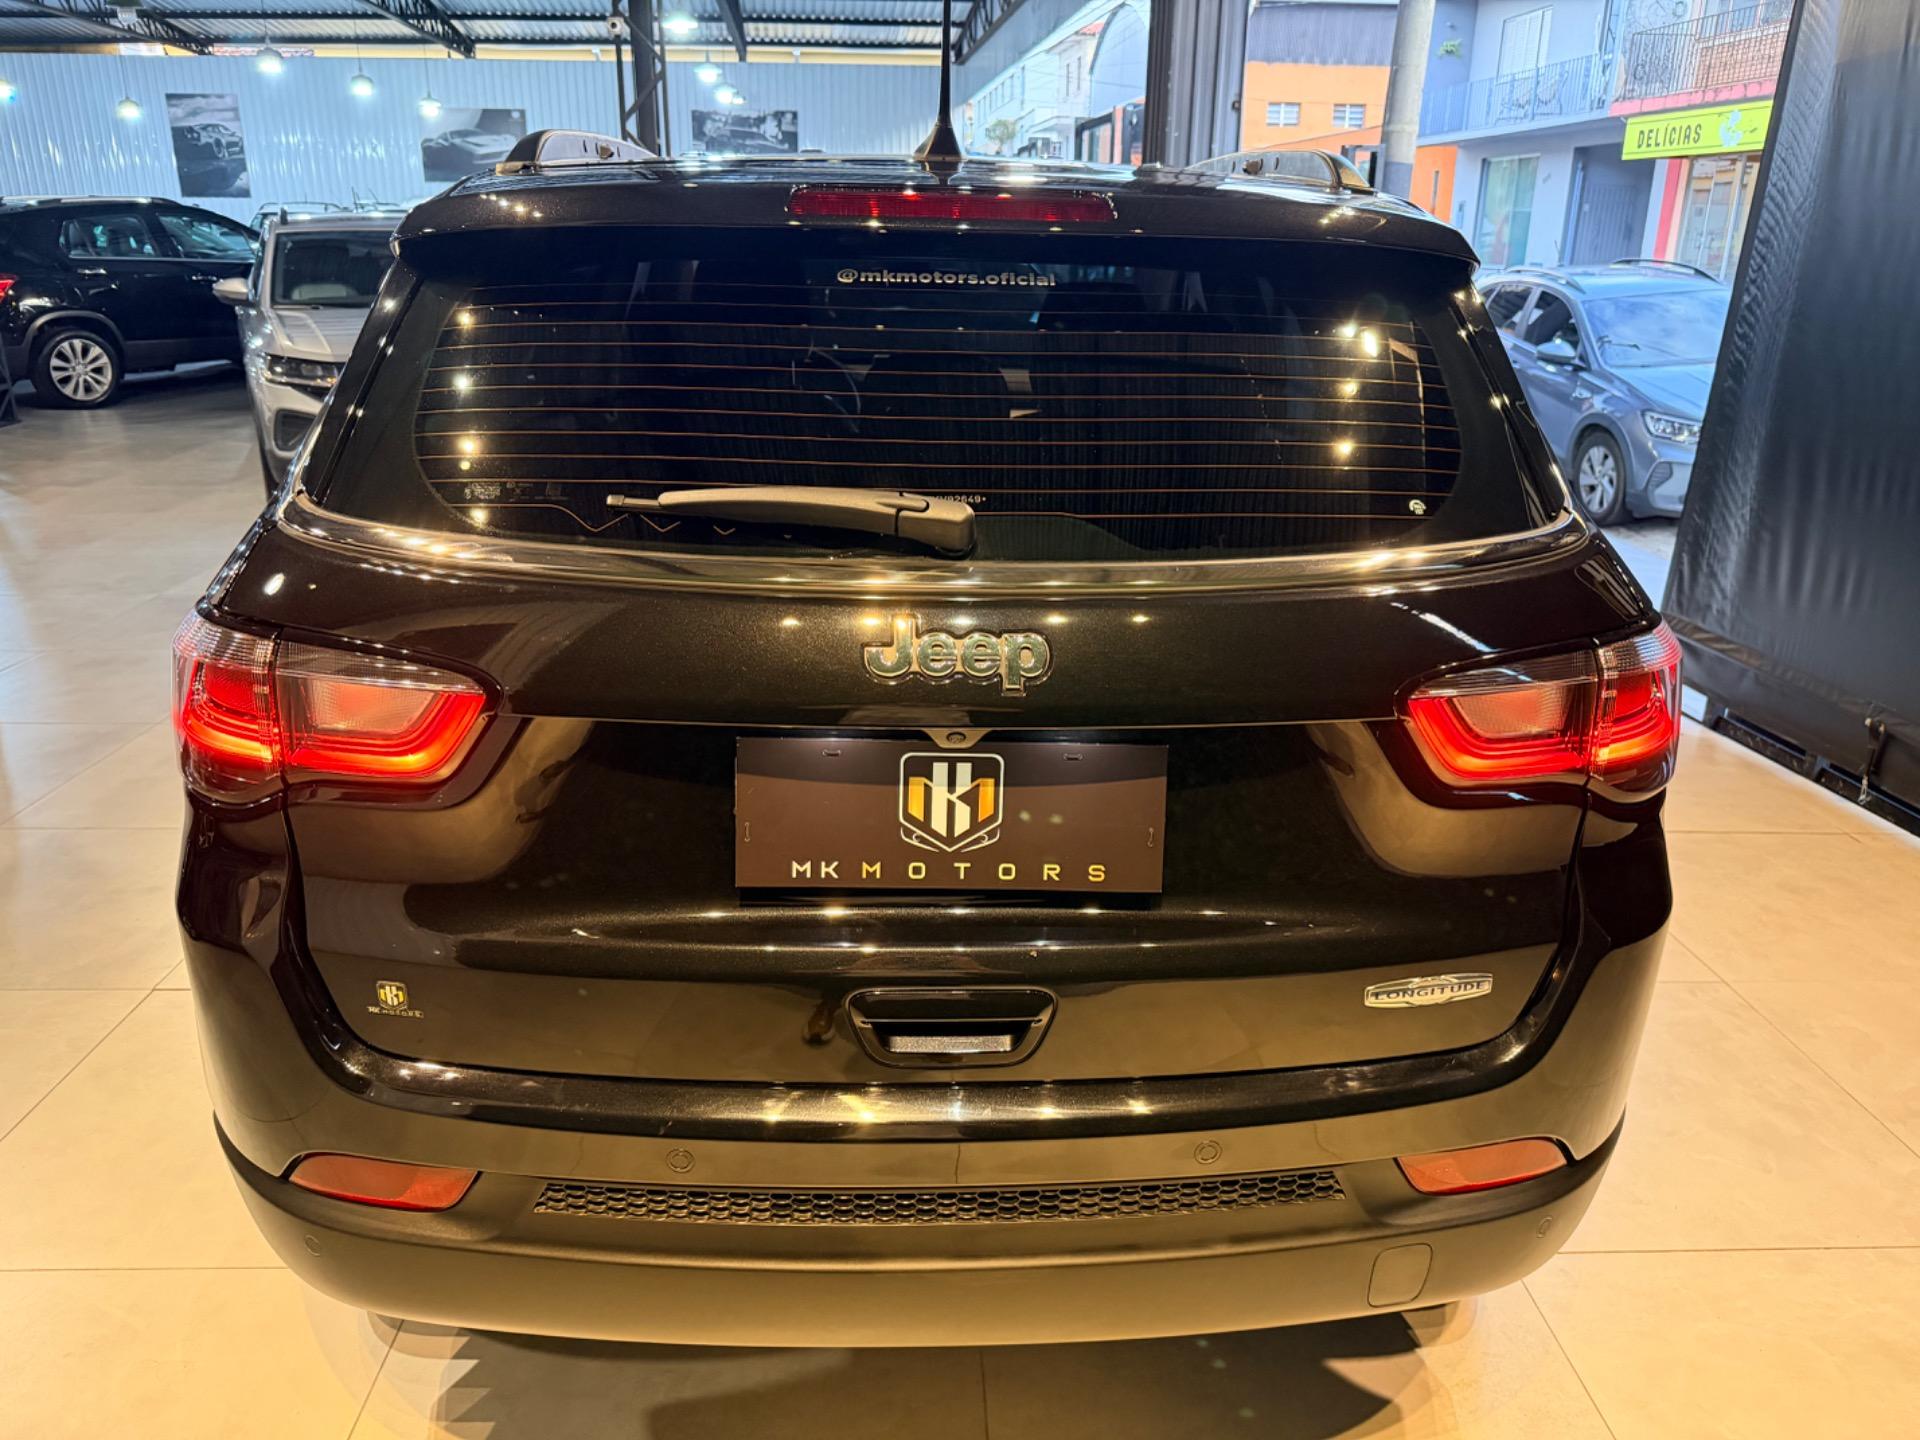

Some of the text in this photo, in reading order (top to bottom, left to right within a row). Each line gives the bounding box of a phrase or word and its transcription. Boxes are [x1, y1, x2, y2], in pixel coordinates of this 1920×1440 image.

[1636, 123, 1703, 149] DELÍCIAS
[837, 268, 1056, 286] @mkmotors.oficial
[863, 614, 1052, 694] Jeep
[791, 860, 1106, 882] MK MOTORS
[1371, 981, 1486, 1001] LONGITUDE
